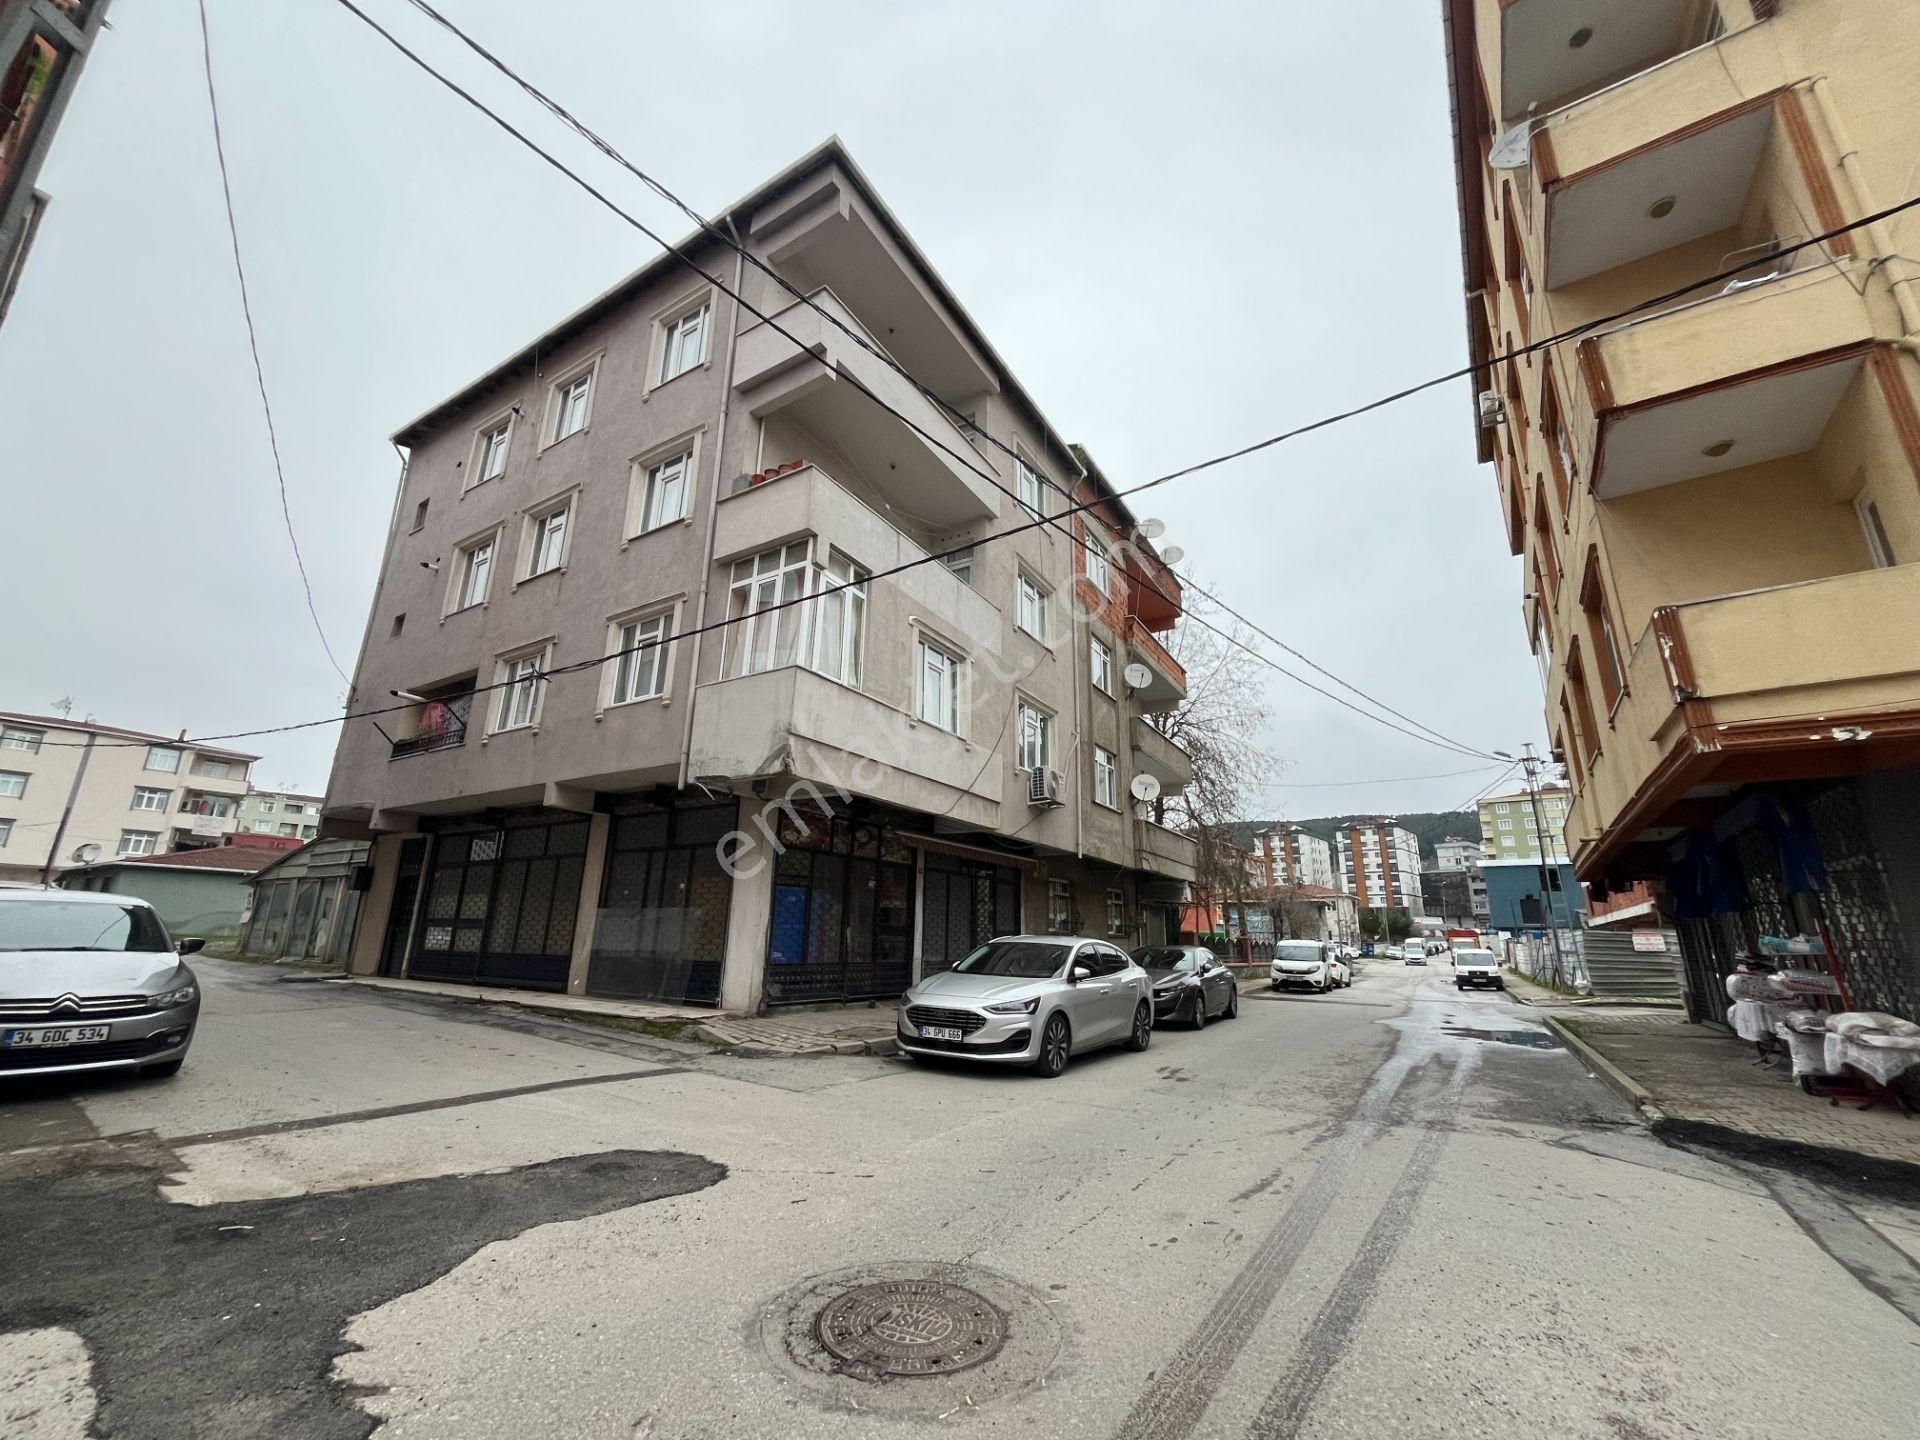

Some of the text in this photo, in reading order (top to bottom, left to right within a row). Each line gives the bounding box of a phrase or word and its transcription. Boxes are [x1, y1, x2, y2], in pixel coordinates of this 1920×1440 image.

[14, 1031, 34, 1044] 34
[77, 1027, 104, 1041] 534
[923, 1026, 931, 1036] 34
